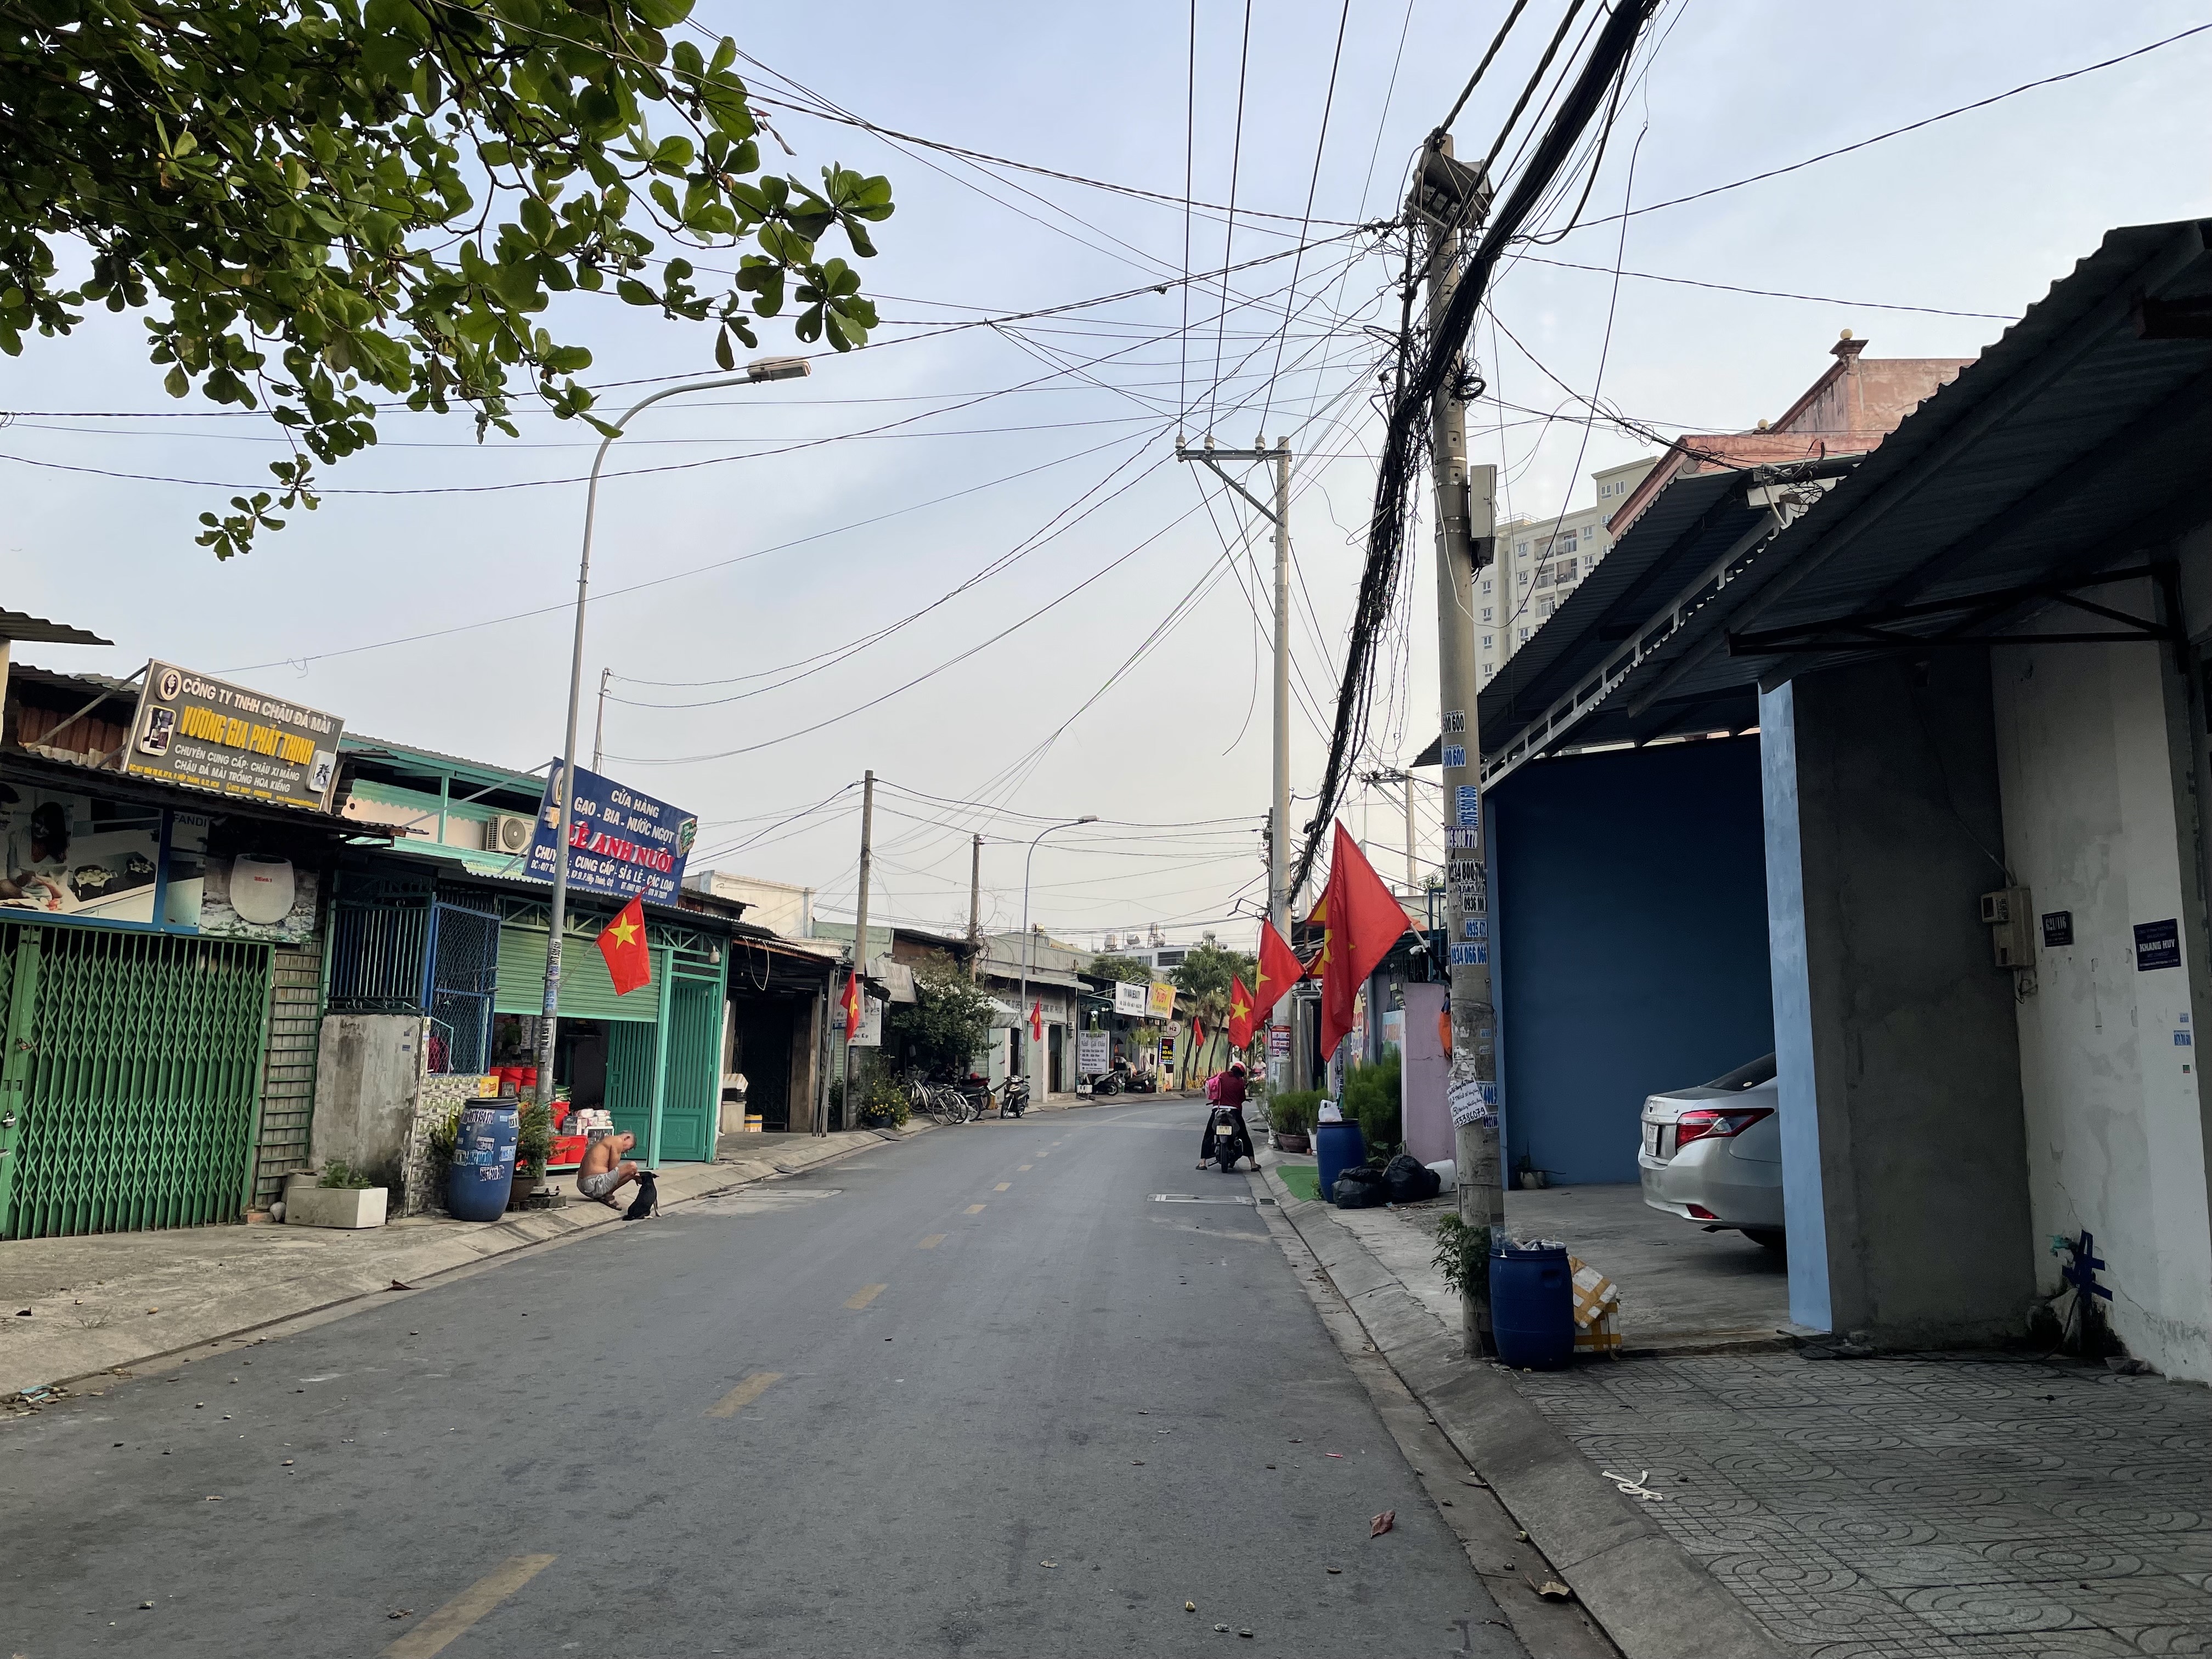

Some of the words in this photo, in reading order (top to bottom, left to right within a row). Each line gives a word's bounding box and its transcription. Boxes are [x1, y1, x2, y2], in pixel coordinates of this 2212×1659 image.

[182, 678, 216, 701] CÔNG
[218, 689, 233, 705] TY
[233, 693, 261, 713] TNHH
[261, 702, 294, 724] CHẬU
[292, 710, 311, 728] ĐÁ
[310, 715, 331, 734] MÀI
[182, 706, 228, 743] VƯƠNG
[225, 717, 249, 749] GIA
[248, 724, 283, 757] PHÁT
[280, 733, 315, 767] THỊNH
[174, 744, 206, 760] CHUYÊN
[207, 752, 229, 765] CUNG
[251, 762, 270, 776] CHẬU
[270, 767, 280, 777] XI
[174, 759, 197, 774] CHẬU
[199, 763, 210, 775] ĐÁ
[211, 766, 227, 779] MÀI
[228, 770, 252, 785] TRỒNG
[253, 777, 269, 788] HOA
[174, 814, 207, 827] FANDI
[574, 797, 597, 816] GẠO
[602, 807, 620, 826] BIA
[627, 816, 651, 836] NƯỚC
[651, 825, 675, 845] NGỌT
[611, 788, 631, 808] CỬA
[633, 798, 660, 819] HÀNG
[568, 820, 591, 849] LÊ
[588, 832, 634, 861] ANH
[631, 845, 675, 874] NUÔI
[574, 855, 599, 872] CUNG
[599, 859, 615, 876] CẤP
[626, 868, 632, 881] &
[633, 868, 644, 884] LẺ
[646, 873, 661, 888] CÁC
[659, 878, 675, 893] LOẠI
[2139, 941, 2162, 953] KHANG
[2162, 939, 2175, 949] HUY
